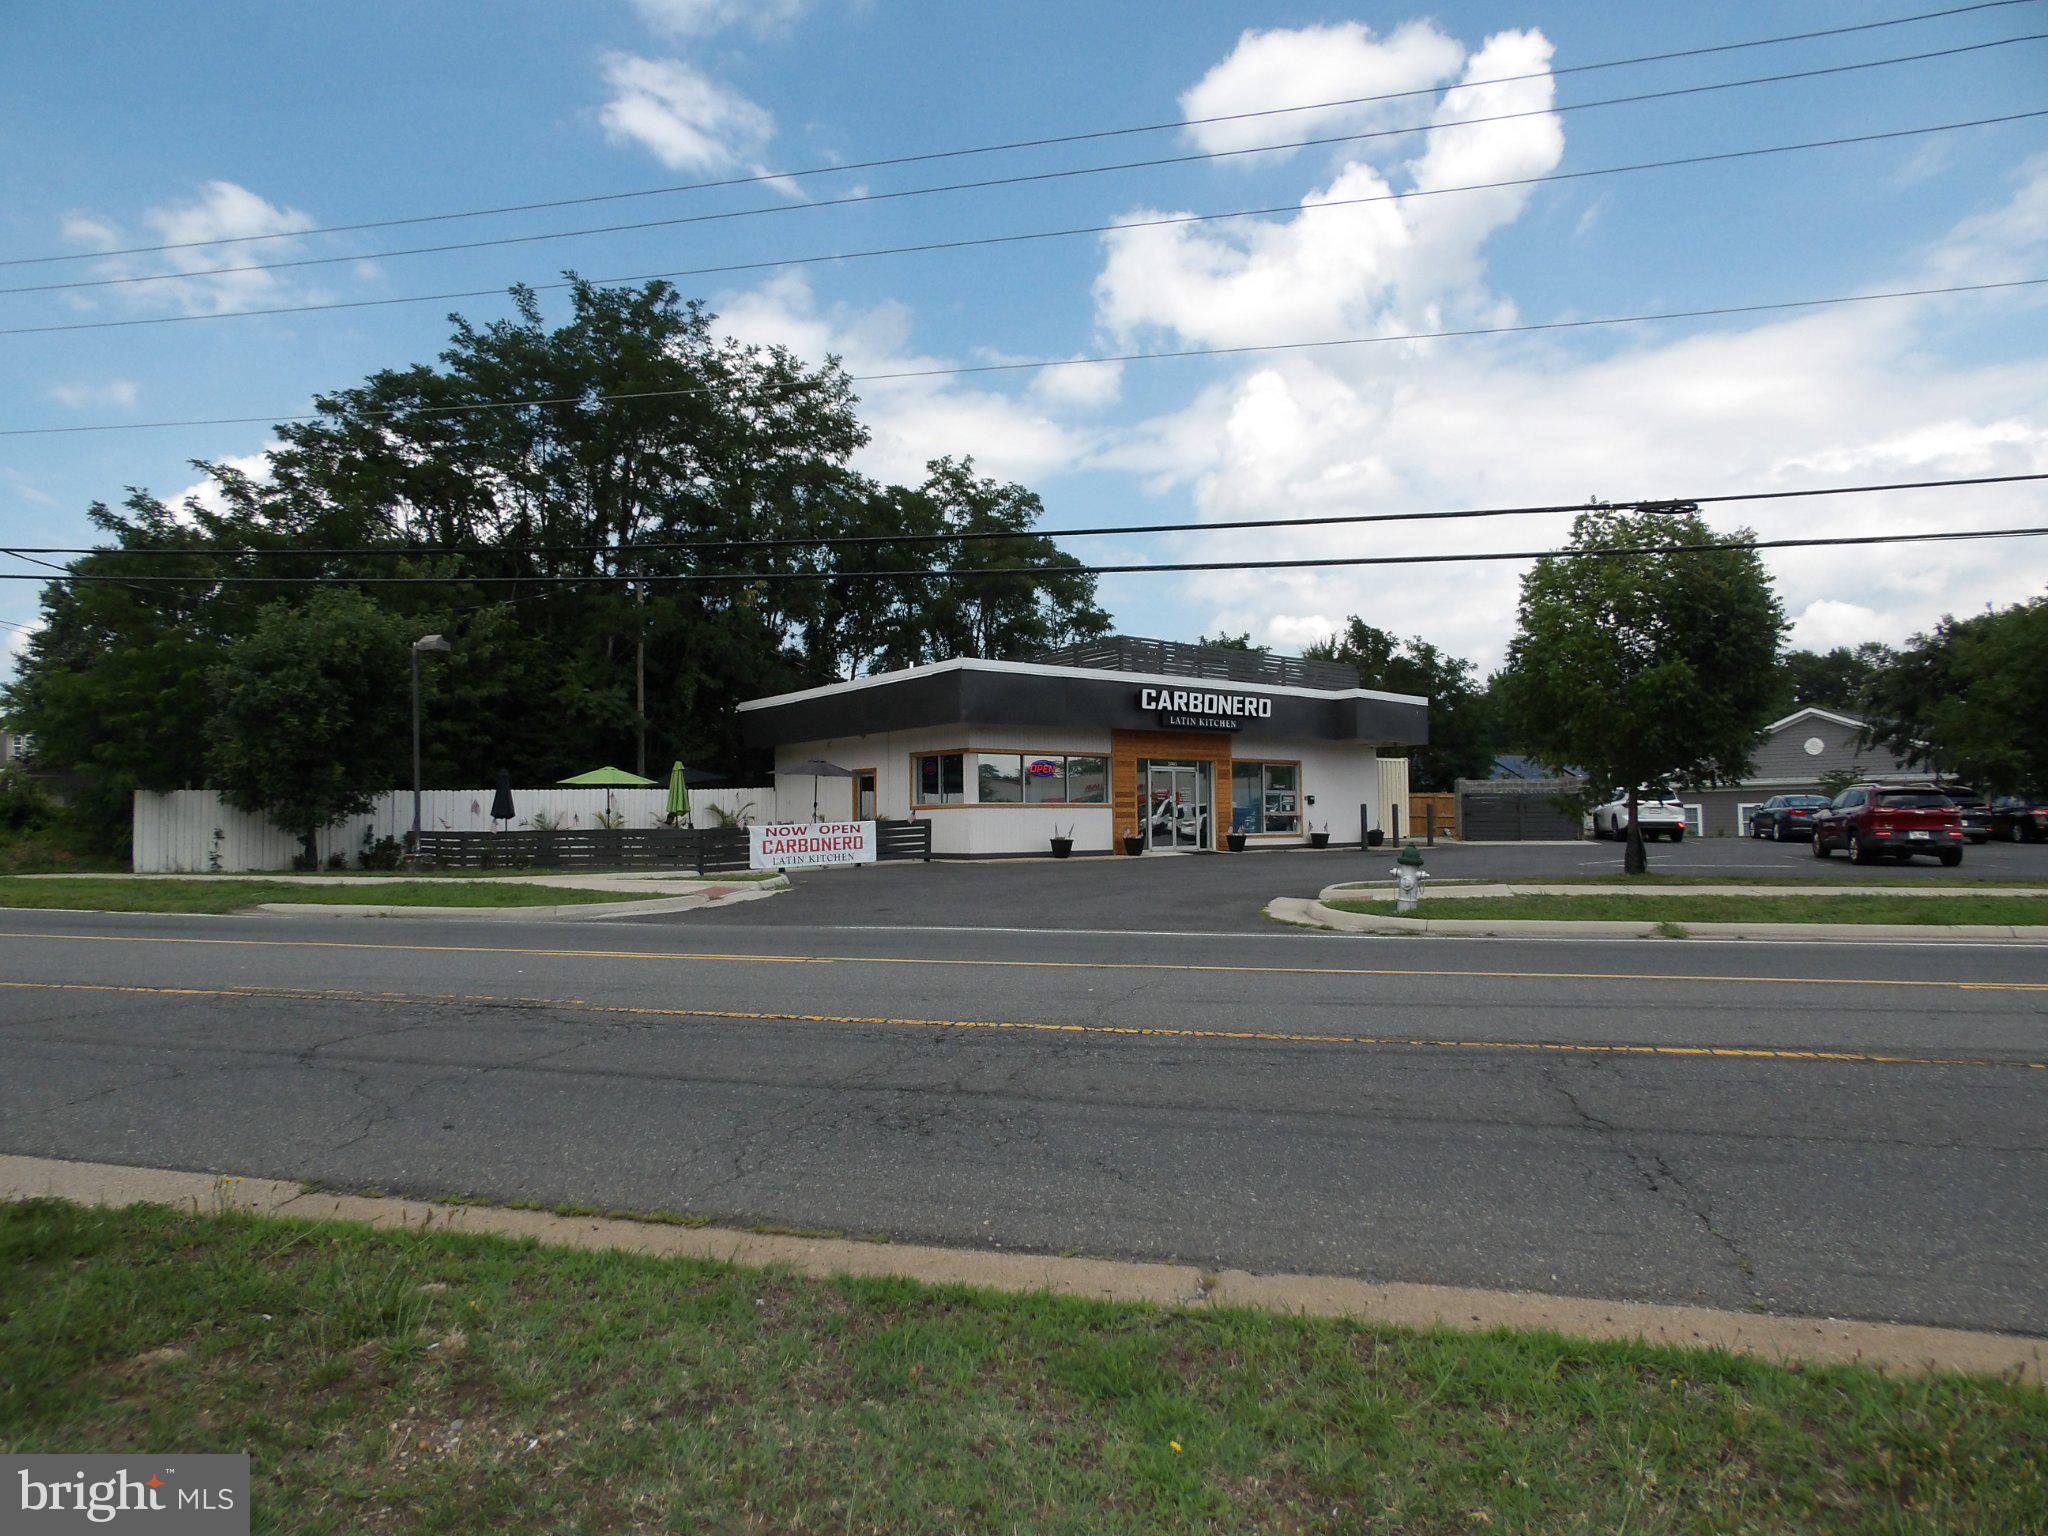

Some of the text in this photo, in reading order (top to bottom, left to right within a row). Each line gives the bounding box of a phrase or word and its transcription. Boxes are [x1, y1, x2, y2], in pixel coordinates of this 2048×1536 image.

[1141, 688, 1272, 718] CARBONERO
[1170, 716, 1237, 728] LATIN KITCHEN
[1030, 764, 1057, 774] OPEN
[765, 824, 861, 837] NOW OPEN
[762, 835, 864, 855] CARBONERO
[772, 852, 855, 866] LATIN KITCHEN
